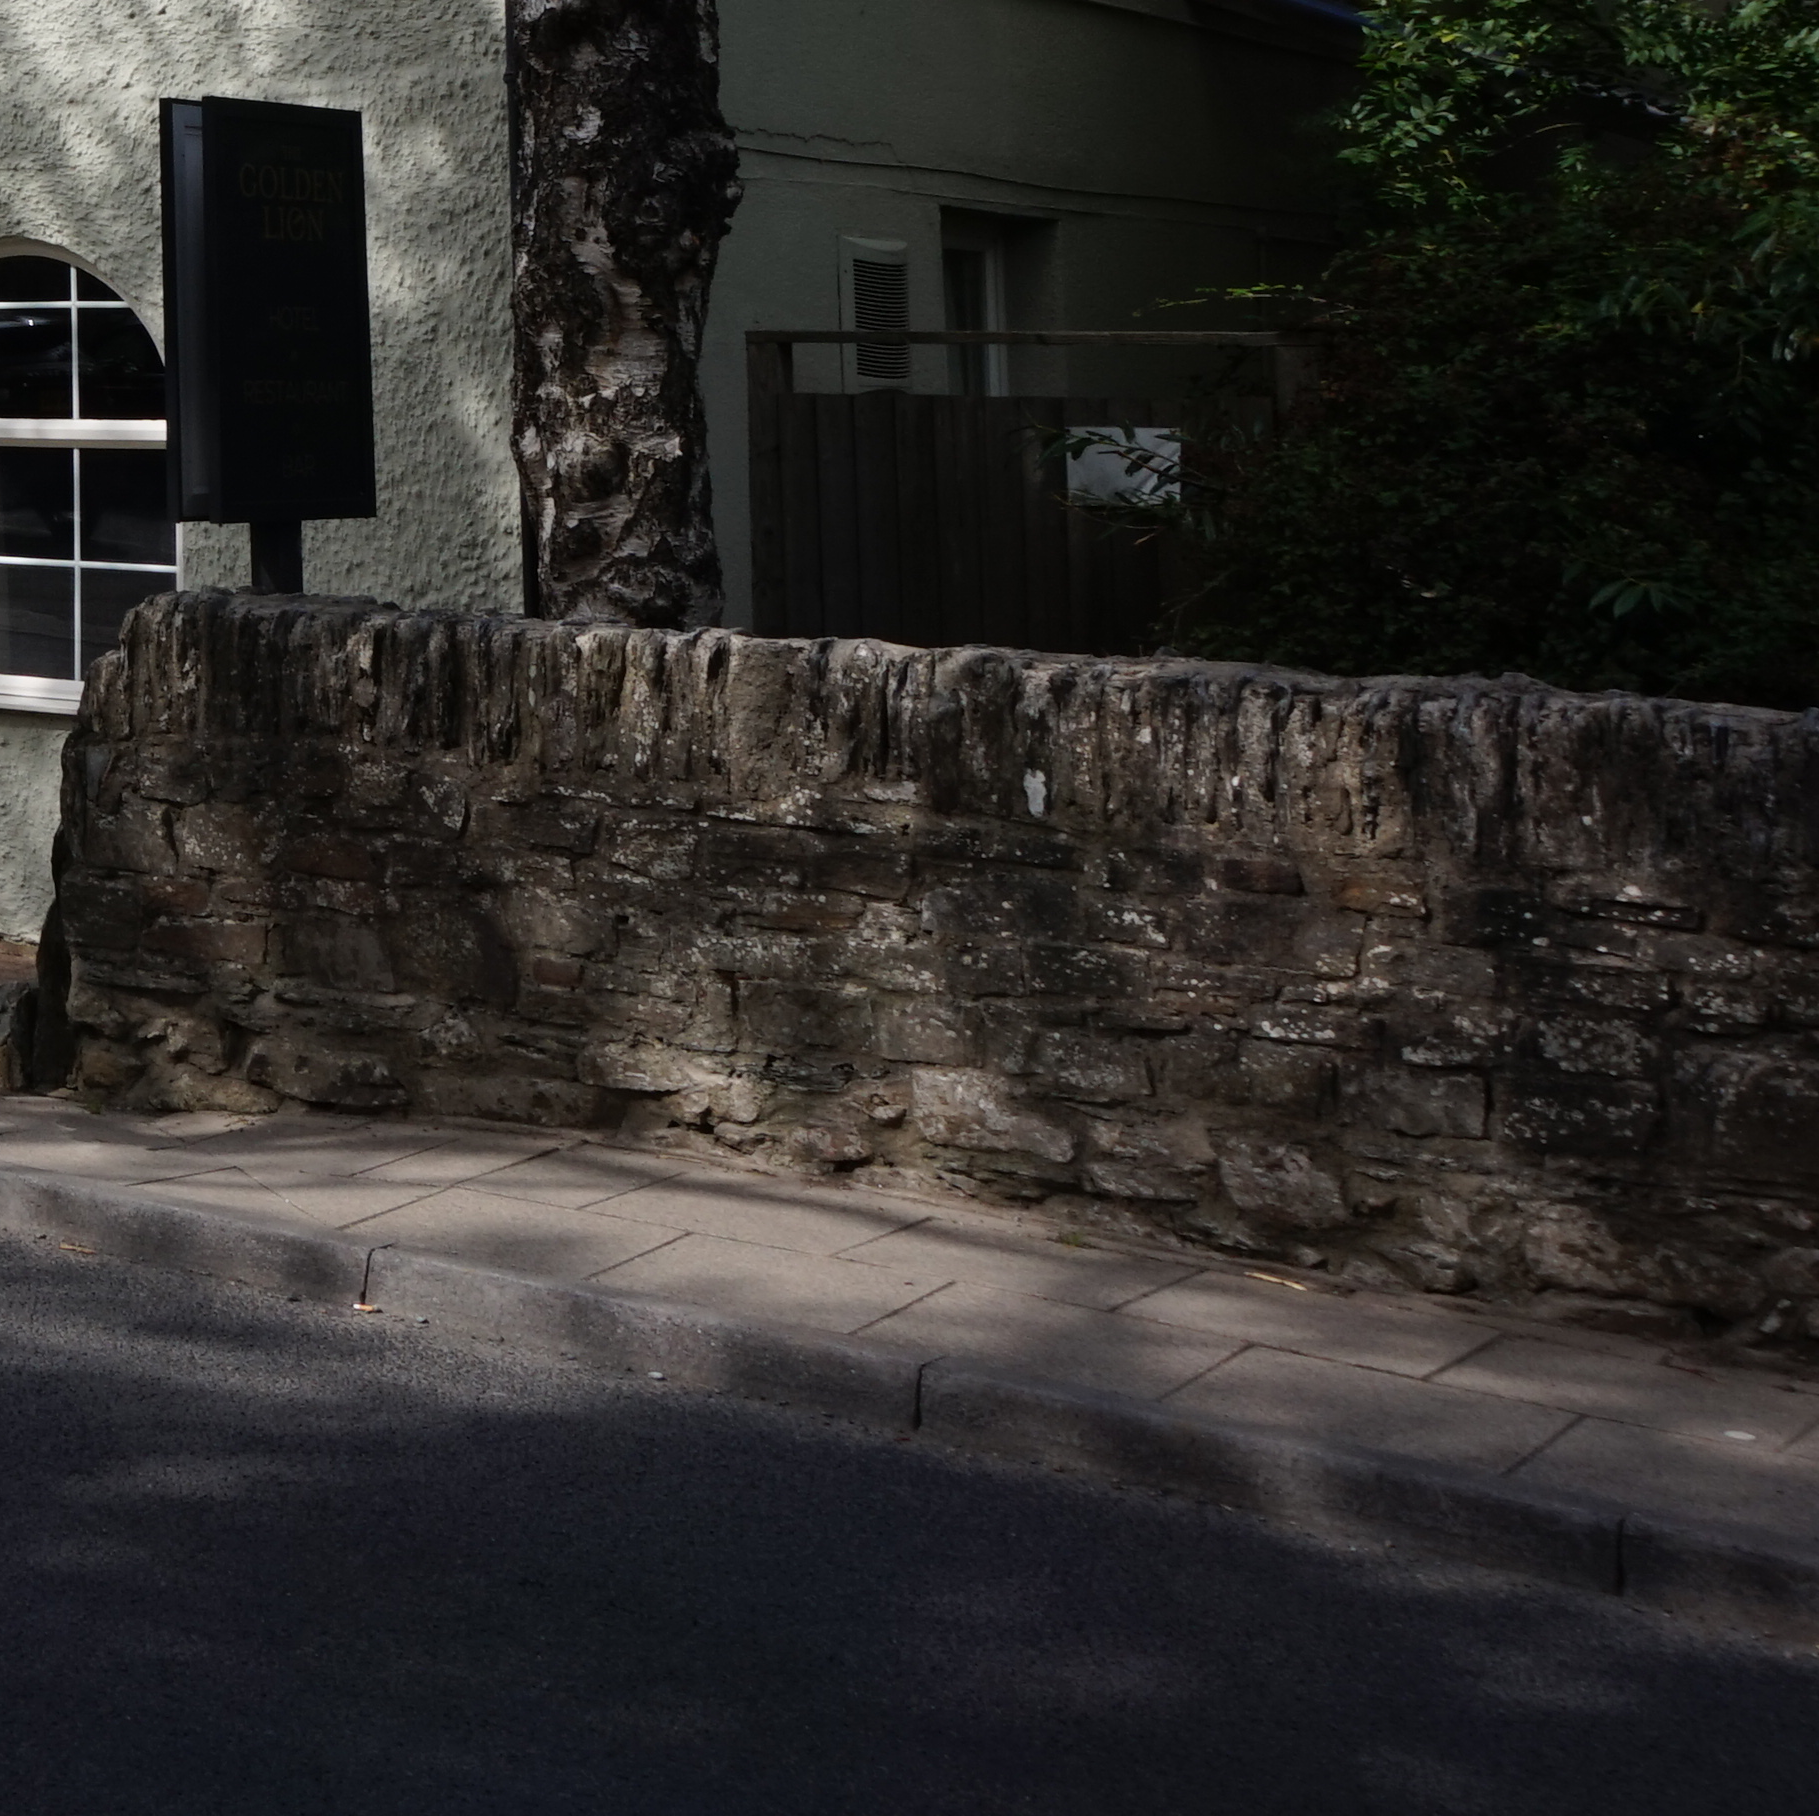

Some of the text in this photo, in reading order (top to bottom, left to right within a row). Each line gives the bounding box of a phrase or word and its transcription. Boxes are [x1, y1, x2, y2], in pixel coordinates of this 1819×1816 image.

[281, 145, 302, 161] THE
[239, 162, 344, 203] GOLDEN
[263, 206, 324, 242] LION
[270, 306, 319, 331] HOTEL
[243, 380, 349, 405] RESTAURANT
[282, 454, 316, 478] BAR
